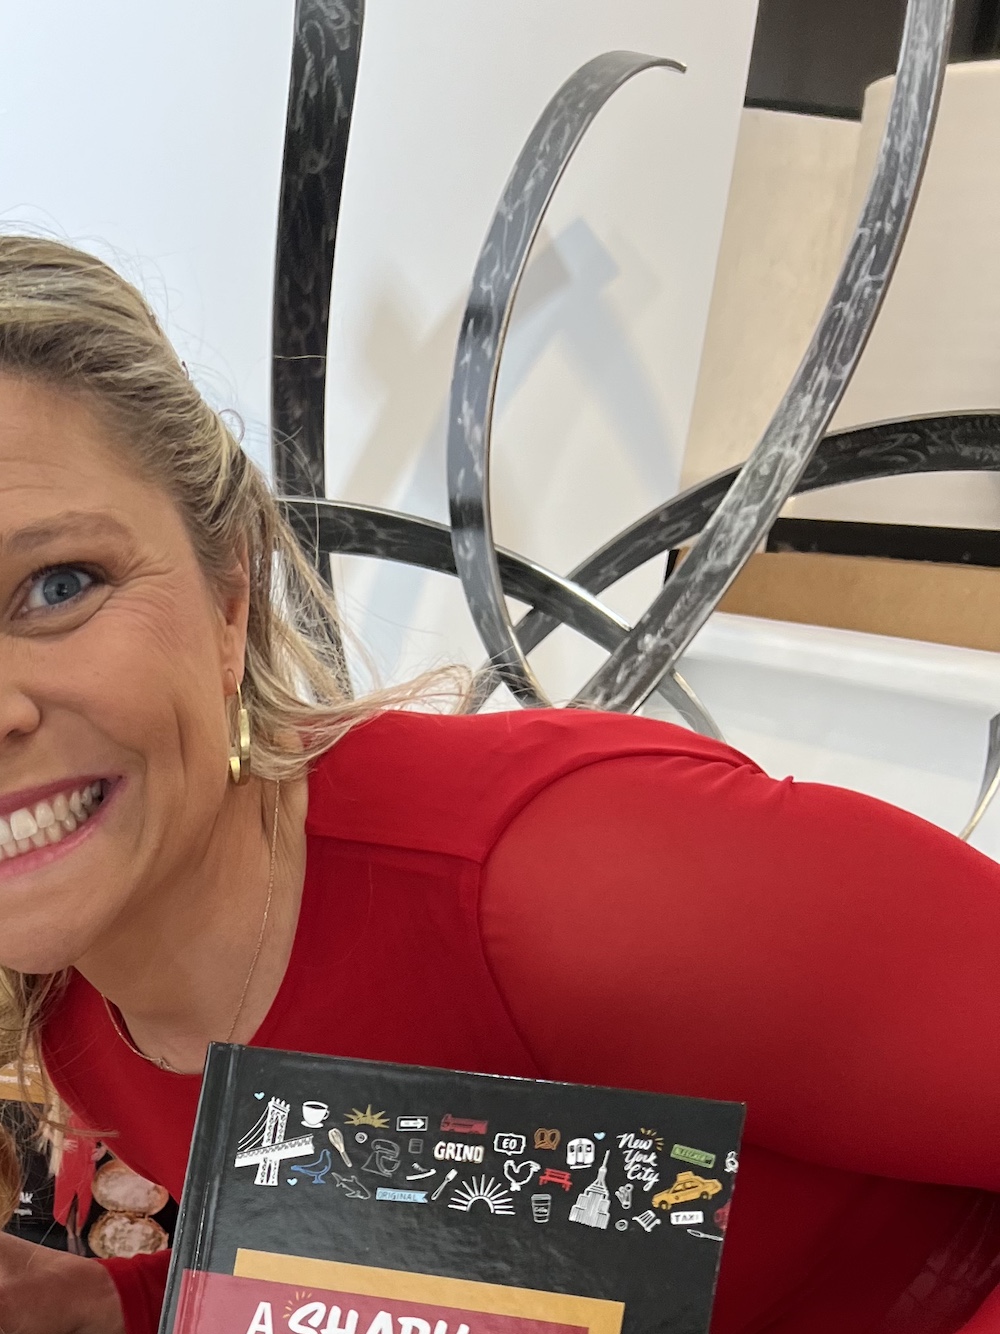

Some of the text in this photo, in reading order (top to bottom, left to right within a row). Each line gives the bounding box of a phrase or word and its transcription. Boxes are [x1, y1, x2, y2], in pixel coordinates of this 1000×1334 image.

[433, 1140, 484, 1163] GRIND
[615, 1132, 653, 1152] New
[622, 1148, 658, 1176] York
[625, 1164, 659, 1192] City
[376, 1188, 421, 1203] ORIGINAL
[674, 1212, 700, 1223] TAXI
